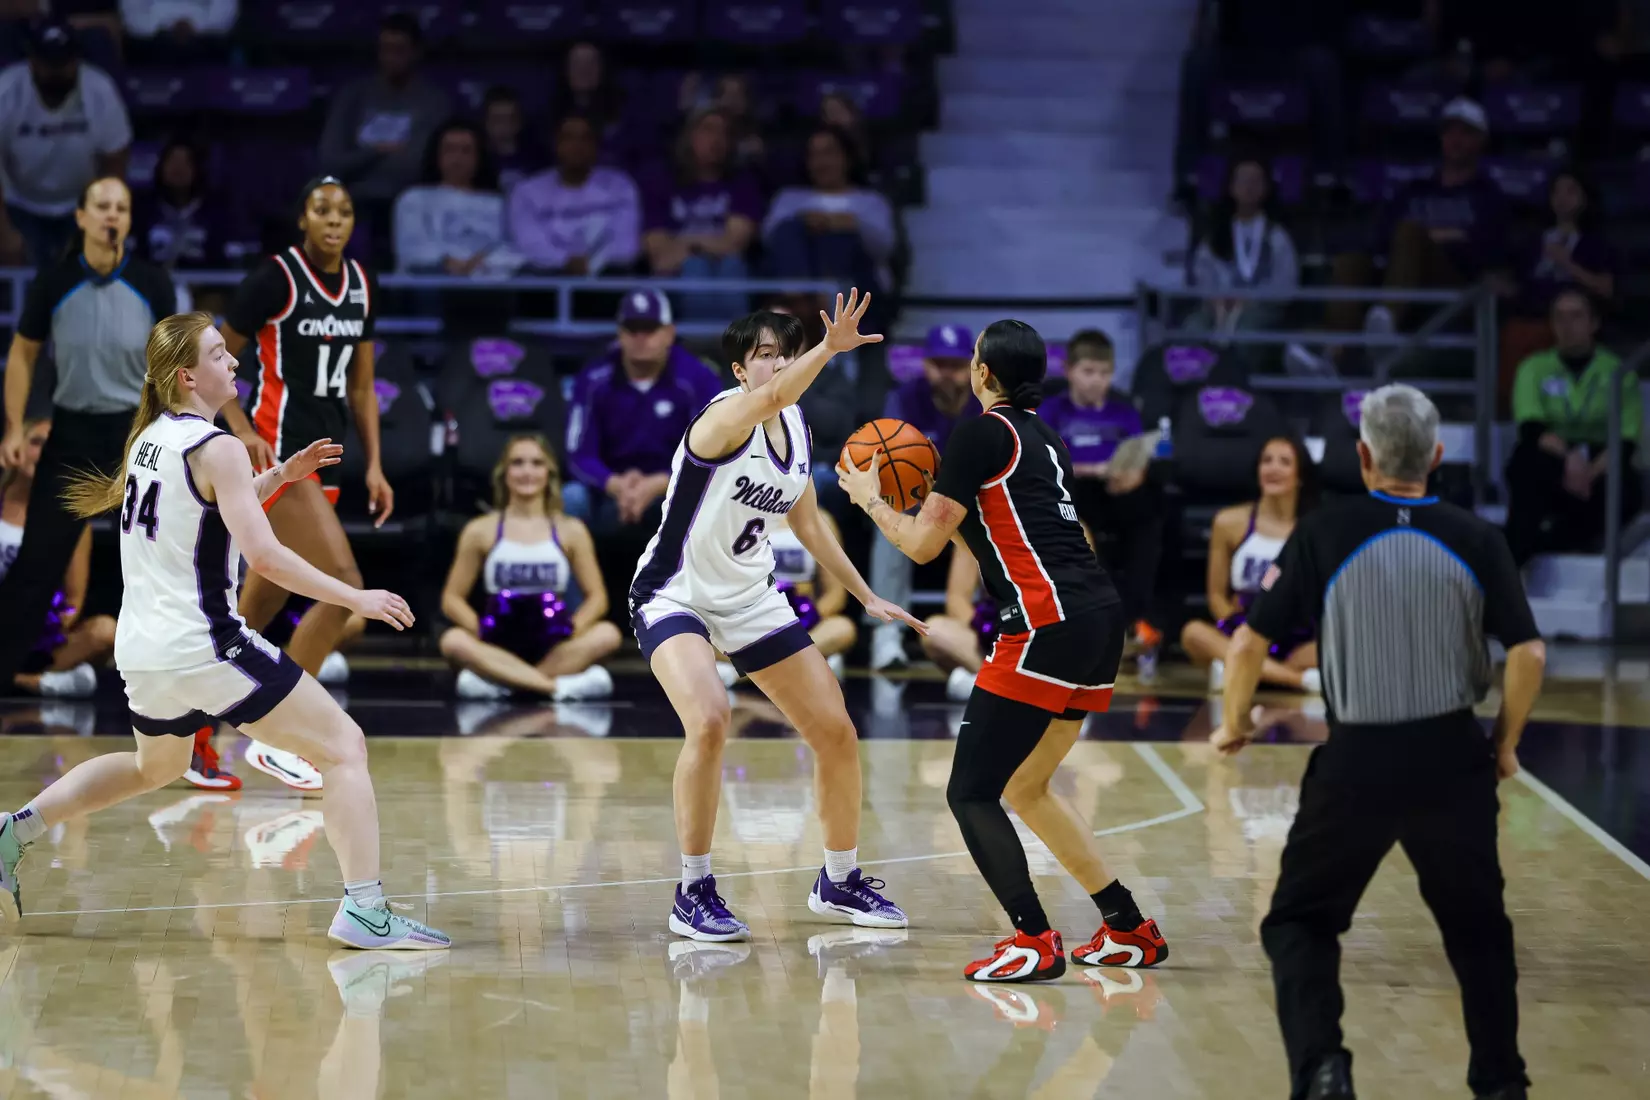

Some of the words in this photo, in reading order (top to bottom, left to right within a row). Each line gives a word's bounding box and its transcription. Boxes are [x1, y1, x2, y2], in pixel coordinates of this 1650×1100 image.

[314, 344, 353, 397] 14
[134, 441, 162, 471] HEAL
[1045, 444, 1071, 501] 1
[122, 473, 161, 541] 34
[732, 517, 765, 556] 6
